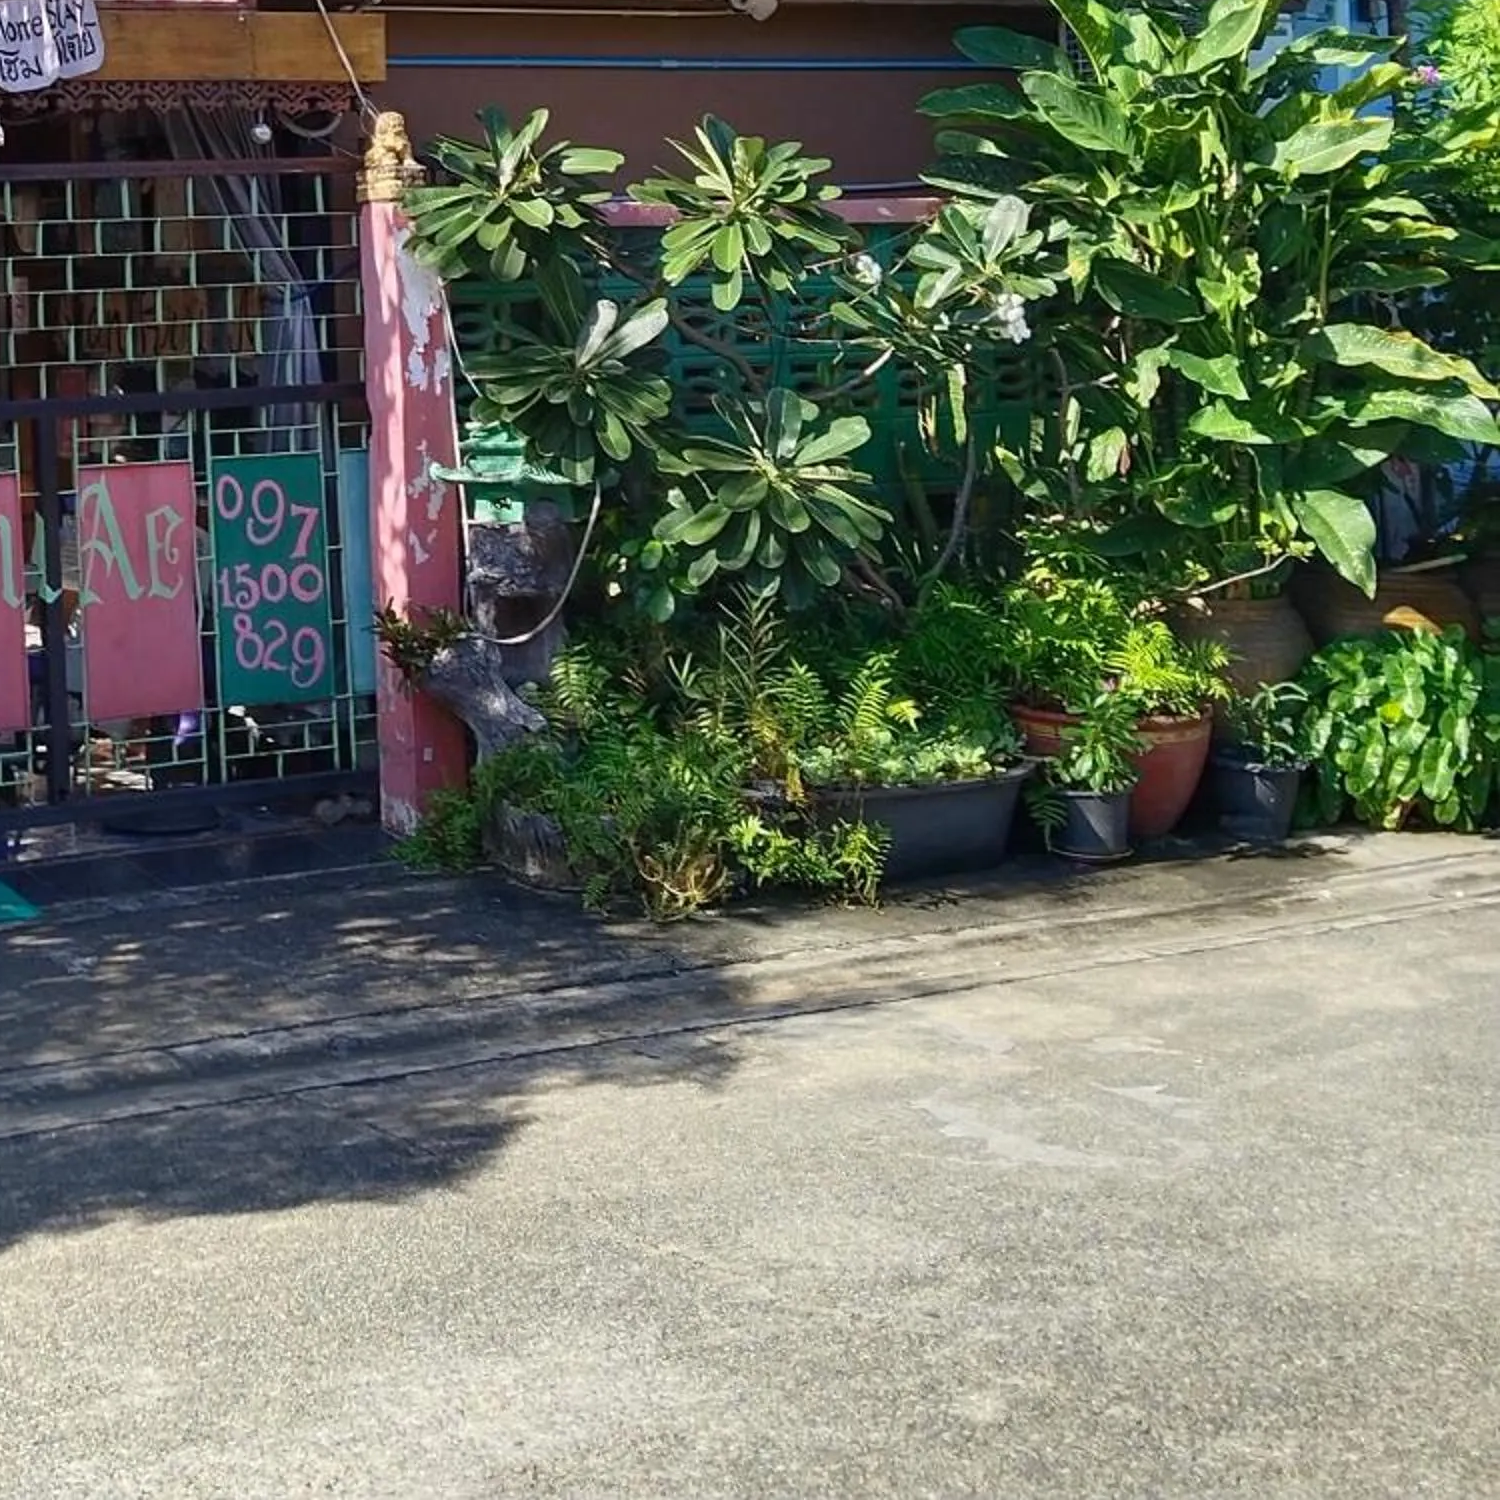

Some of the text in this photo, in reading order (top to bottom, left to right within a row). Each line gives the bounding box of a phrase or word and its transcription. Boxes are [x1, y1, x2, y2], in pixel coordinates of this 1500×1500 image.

[215, 474, 320, 560] 097
[218, 562, 325, 610] 1500
[232, 612, 326, 689] 829
